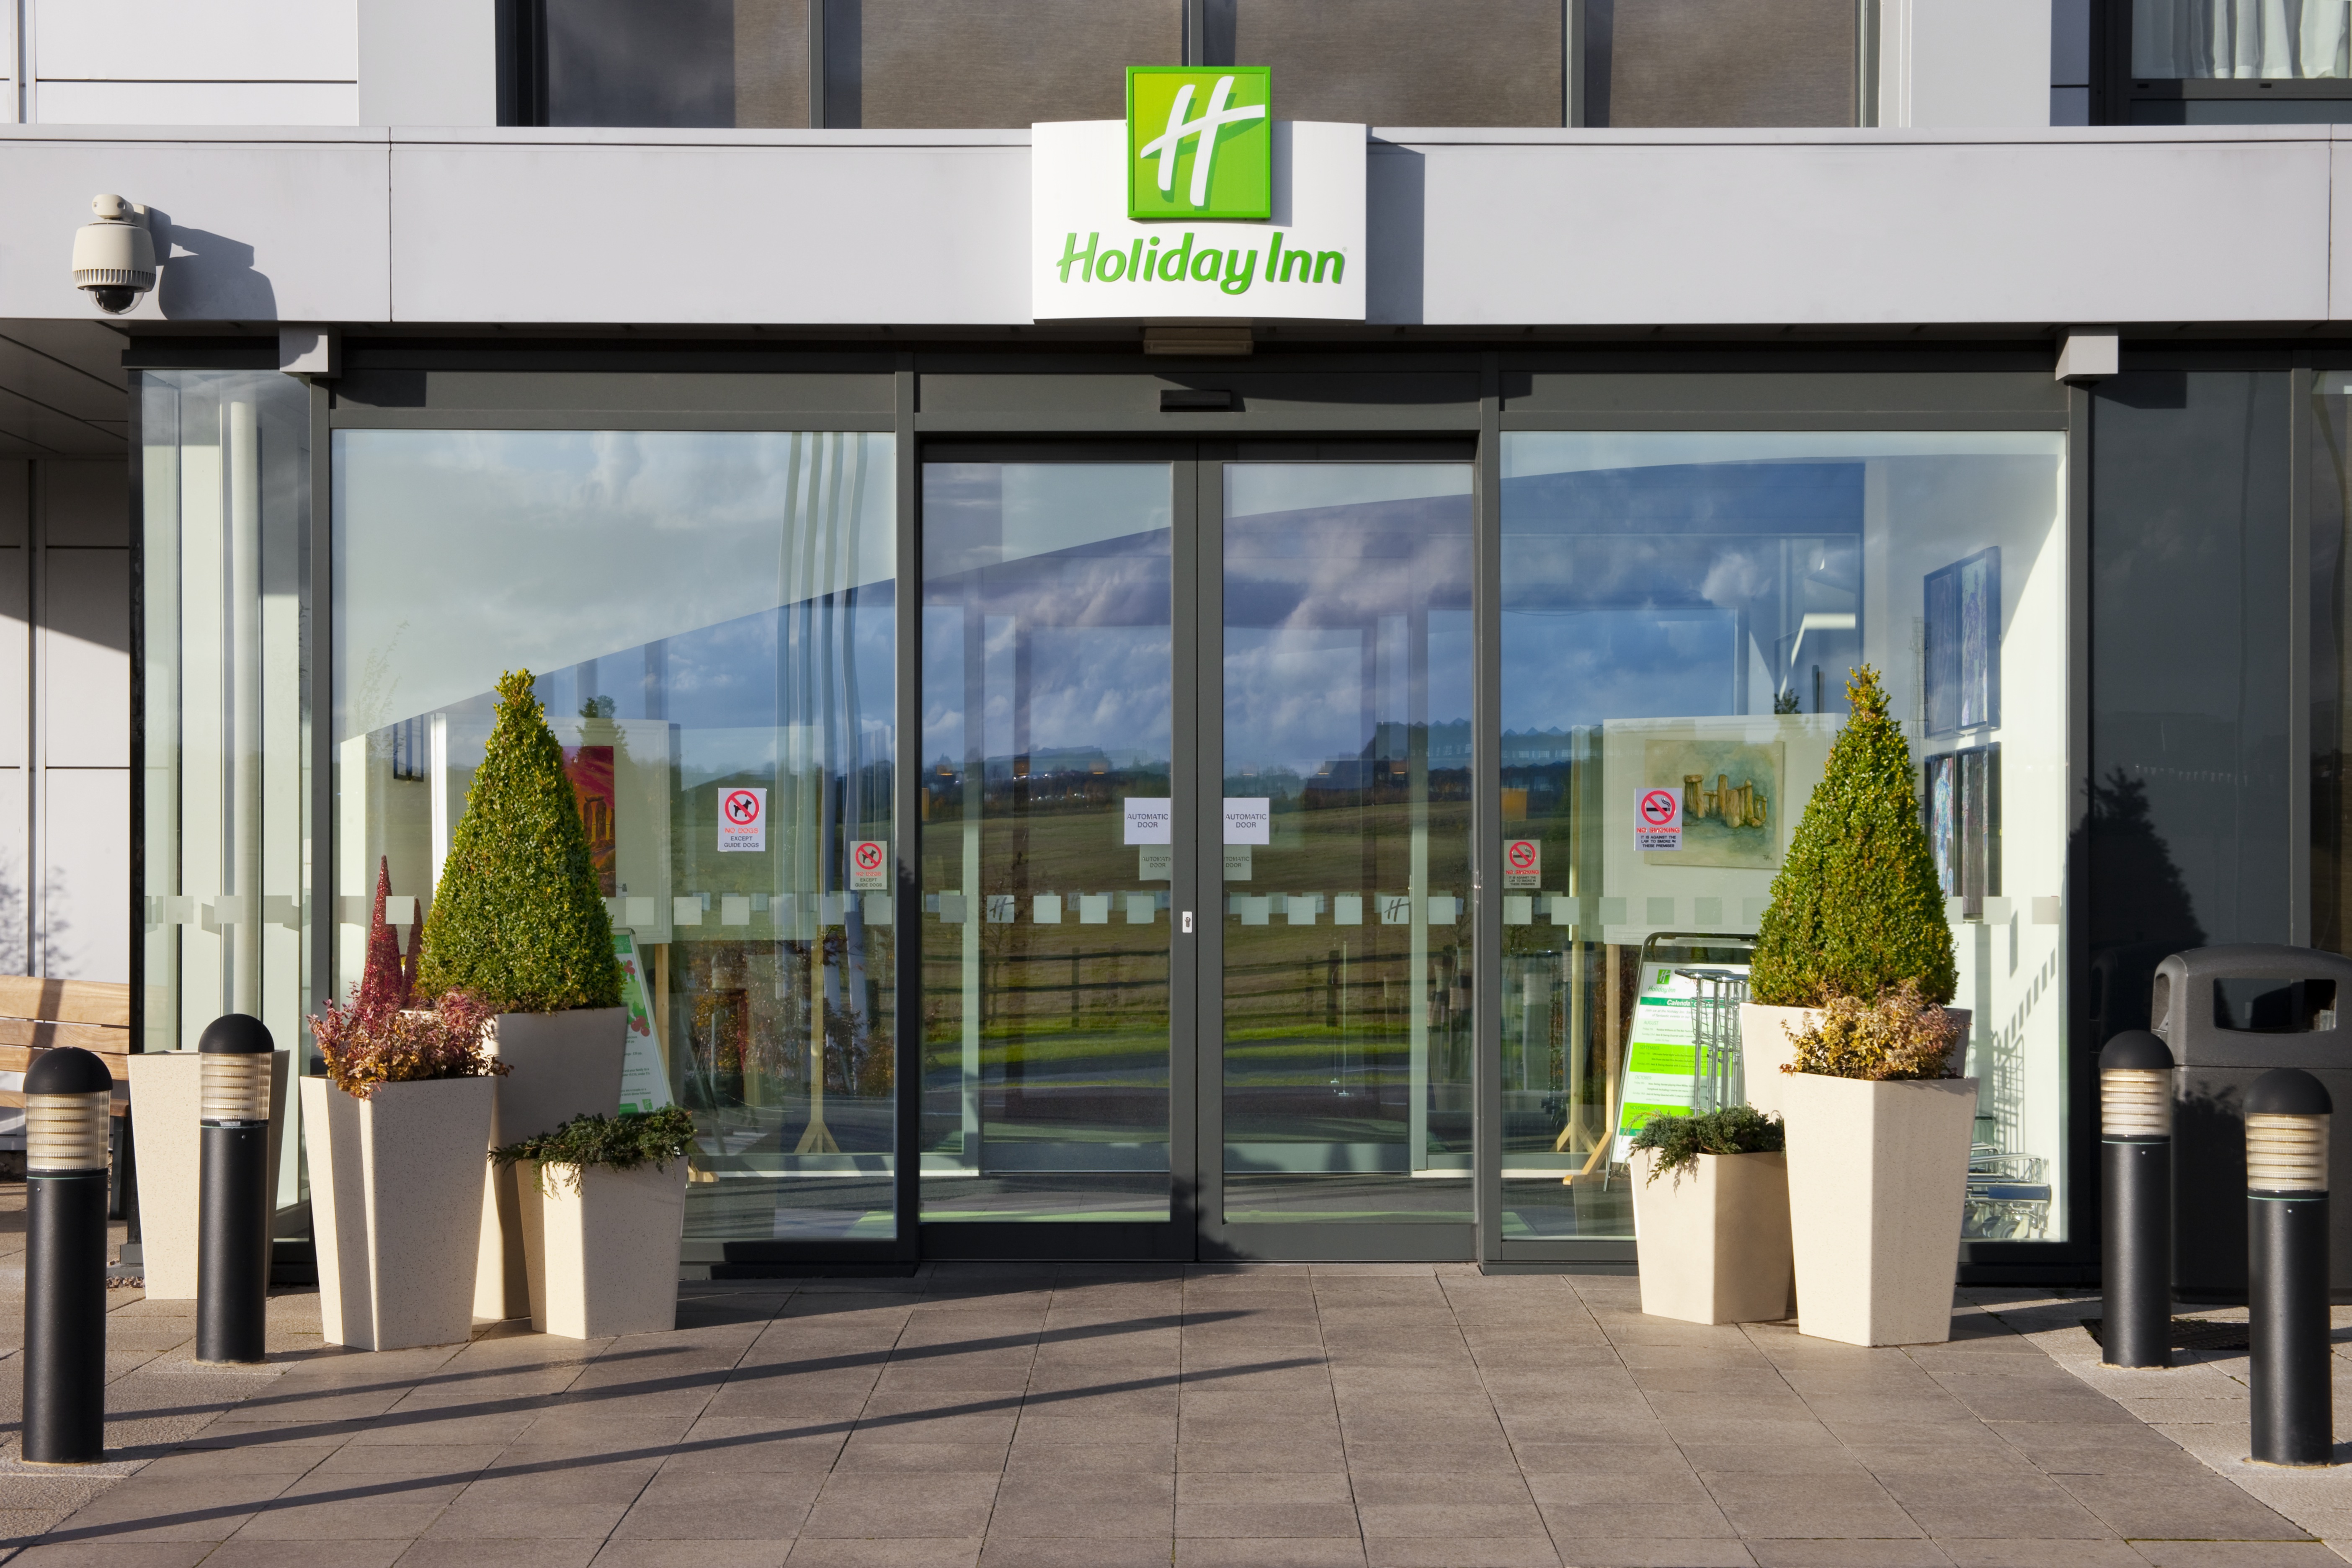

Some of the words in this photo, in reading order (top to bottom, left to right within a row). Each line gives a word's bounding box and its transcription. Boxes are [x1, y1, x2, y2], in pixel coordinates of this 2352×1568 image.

[1057, 232, 1258, 295] Holiday
[1265, 232, 1344, 284] Inn
[1648, 985, 1668, 993] Holiday
